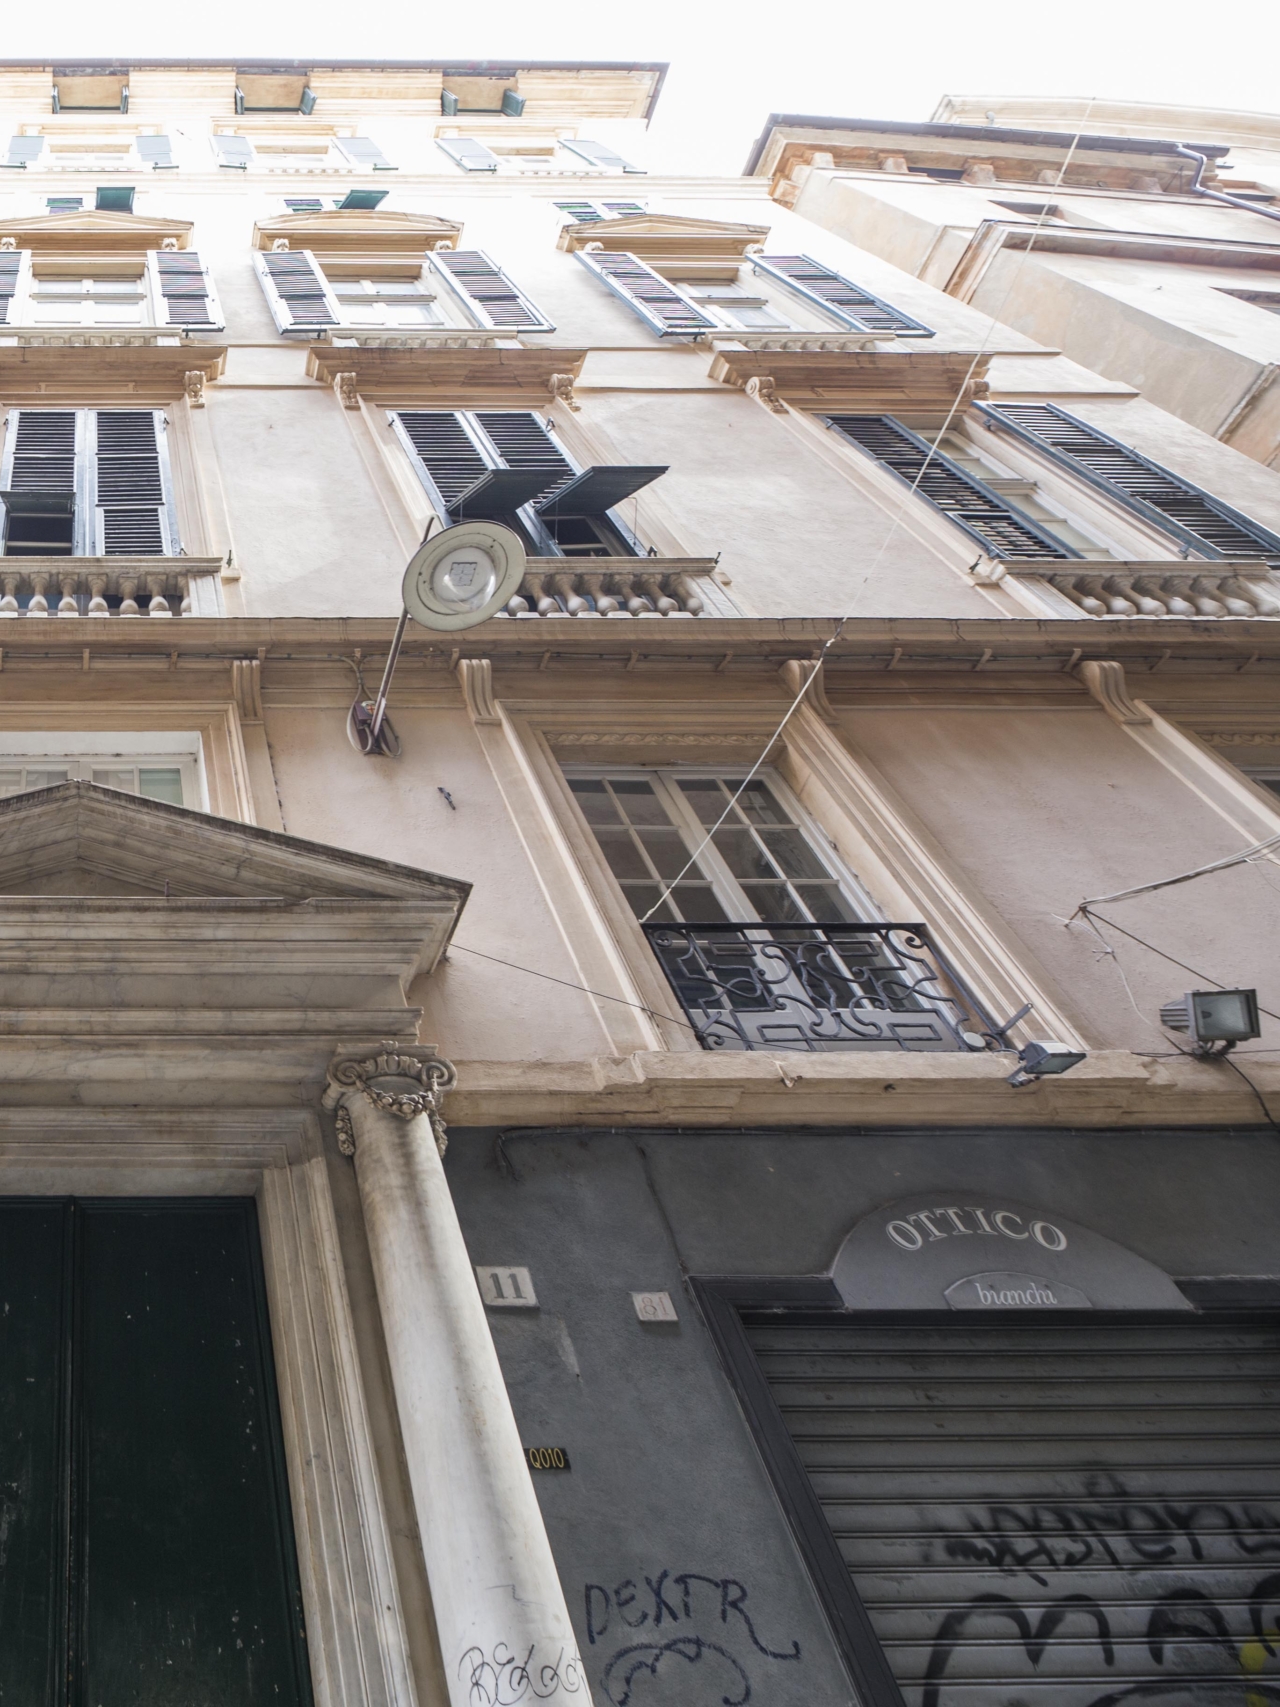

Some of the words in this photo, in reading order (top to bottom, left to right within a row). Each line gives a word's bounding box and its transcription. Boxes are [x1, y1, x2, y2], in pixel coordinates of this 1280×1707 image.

[886, 1206, 1068, 1251] OTTICO
[489, 1272, 527, 1300] 11
[974, 1282, 1058, 1305] bianchi
[641, 1295, 670, 1317] 81
[529, 1447, 565, 1470] Q010
